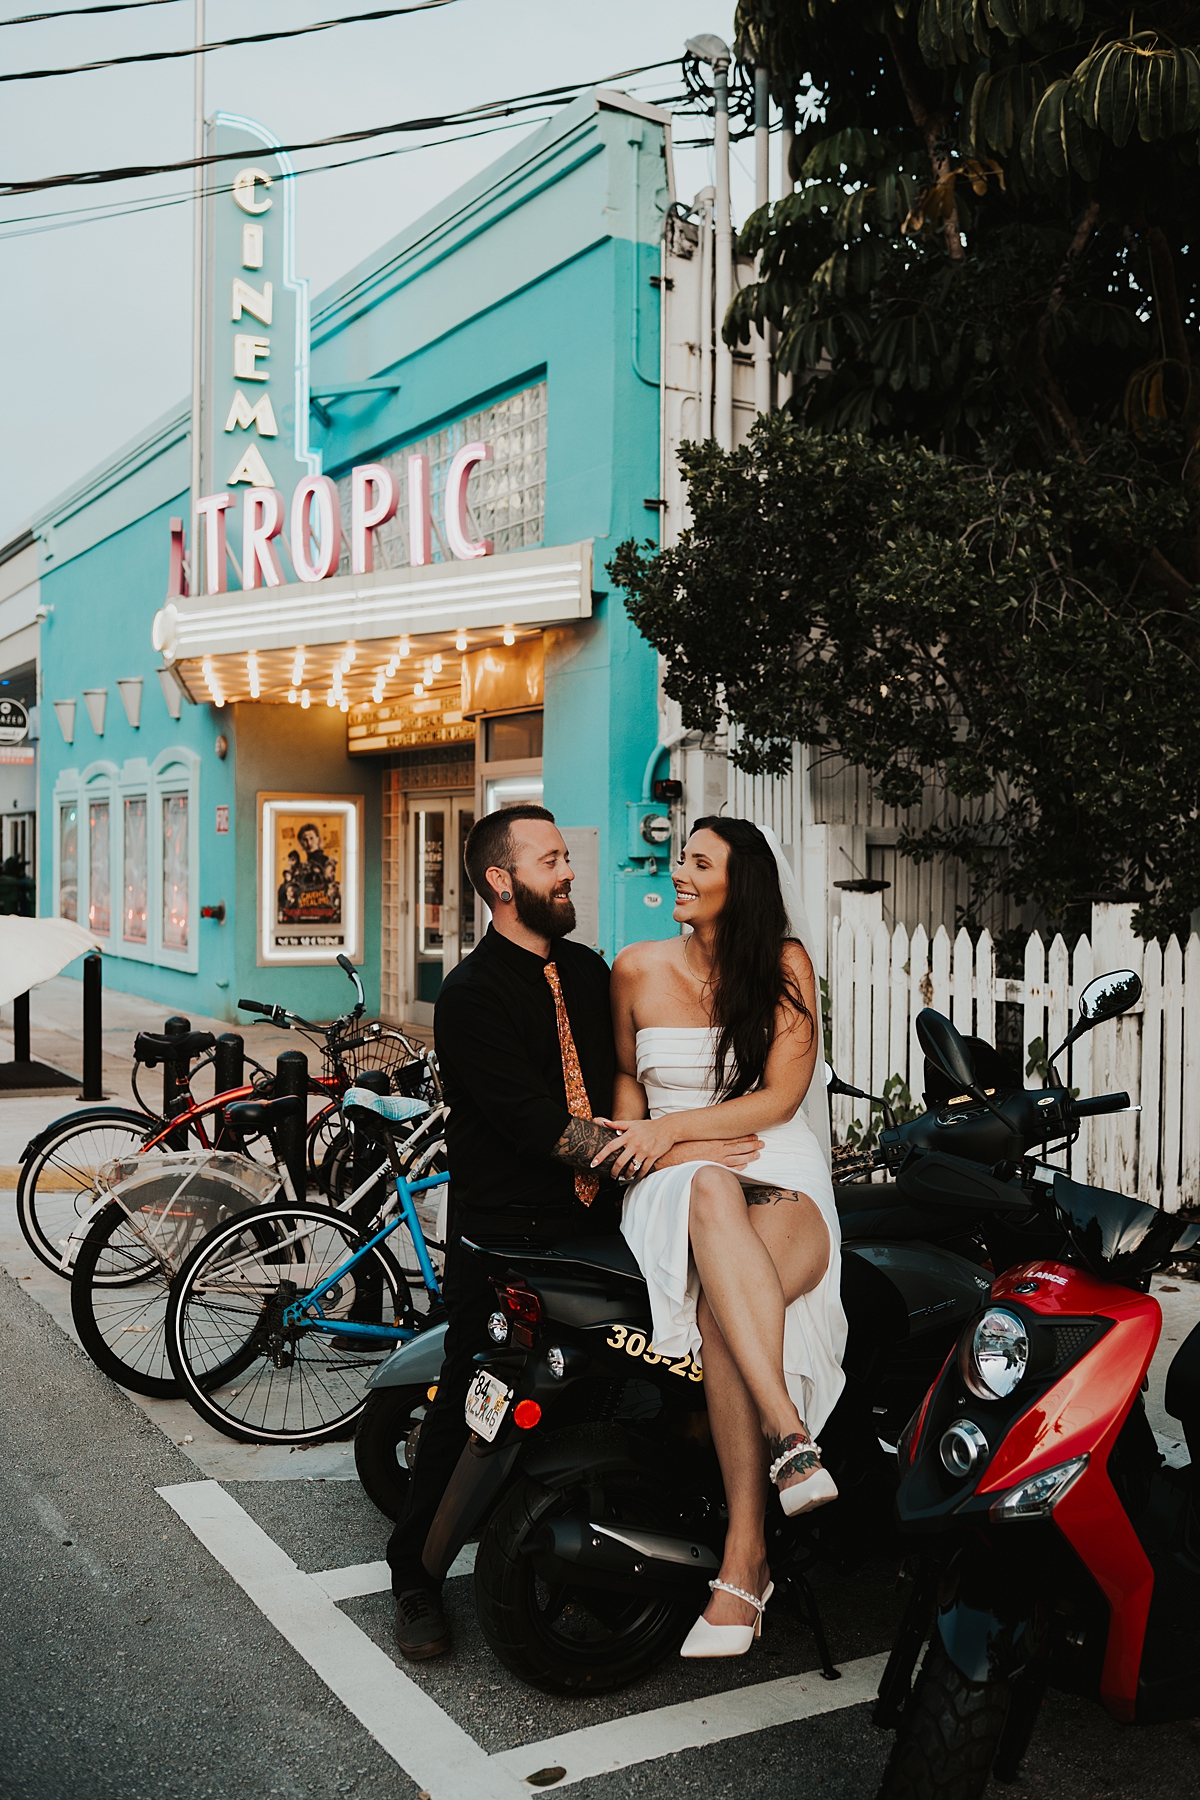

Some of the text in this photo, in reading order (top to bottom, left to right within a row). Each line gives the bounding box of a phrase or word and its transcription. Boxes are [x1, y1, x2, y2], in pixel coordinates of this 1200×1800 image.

[224, 167, 279, 488] CINEMA
[196, 441, 494, 595] TROPIC
[1027, 1271, 1069, 1286] LANCE
[475, 1375, 491, 1400] 84
